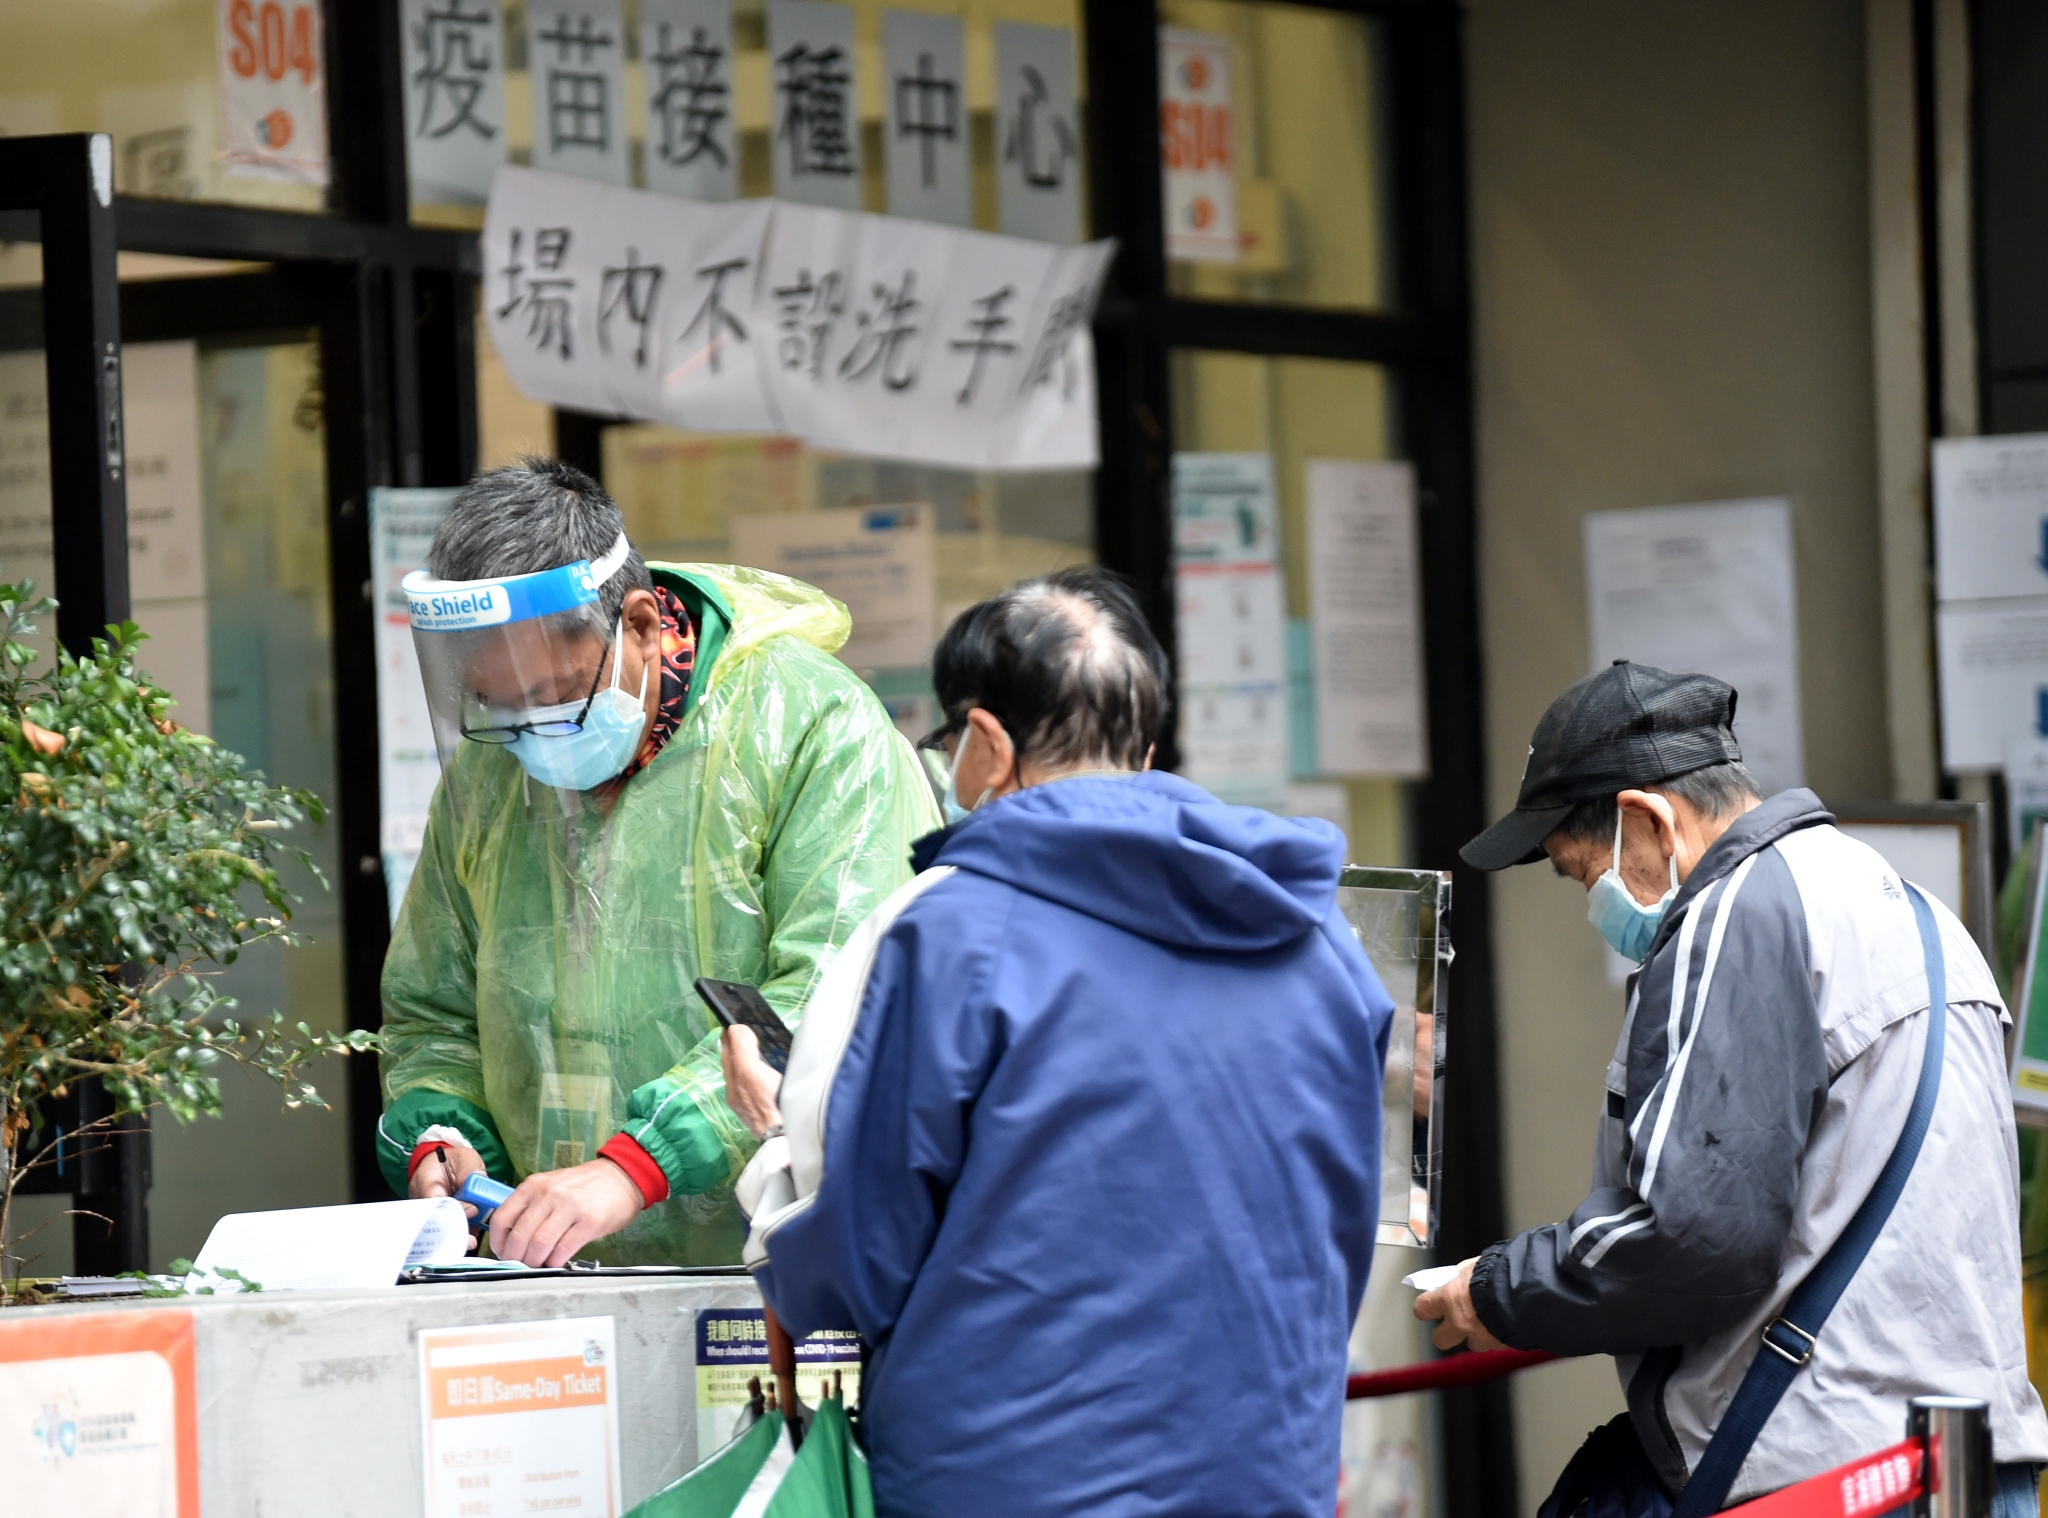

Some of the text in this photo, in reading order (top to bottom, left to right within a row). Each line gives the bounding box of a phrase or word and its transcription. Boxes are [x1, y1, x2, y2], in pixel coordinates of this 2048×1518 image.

[409, 0, 1079, 190] 疫苗接種中心
[406, 591, 494, 616] ace Shield
[435, 615, 477, 628] protection
[804, 1344, 834, 1354] COVID-19
[562, 1371, 603, 1395] Ticket
